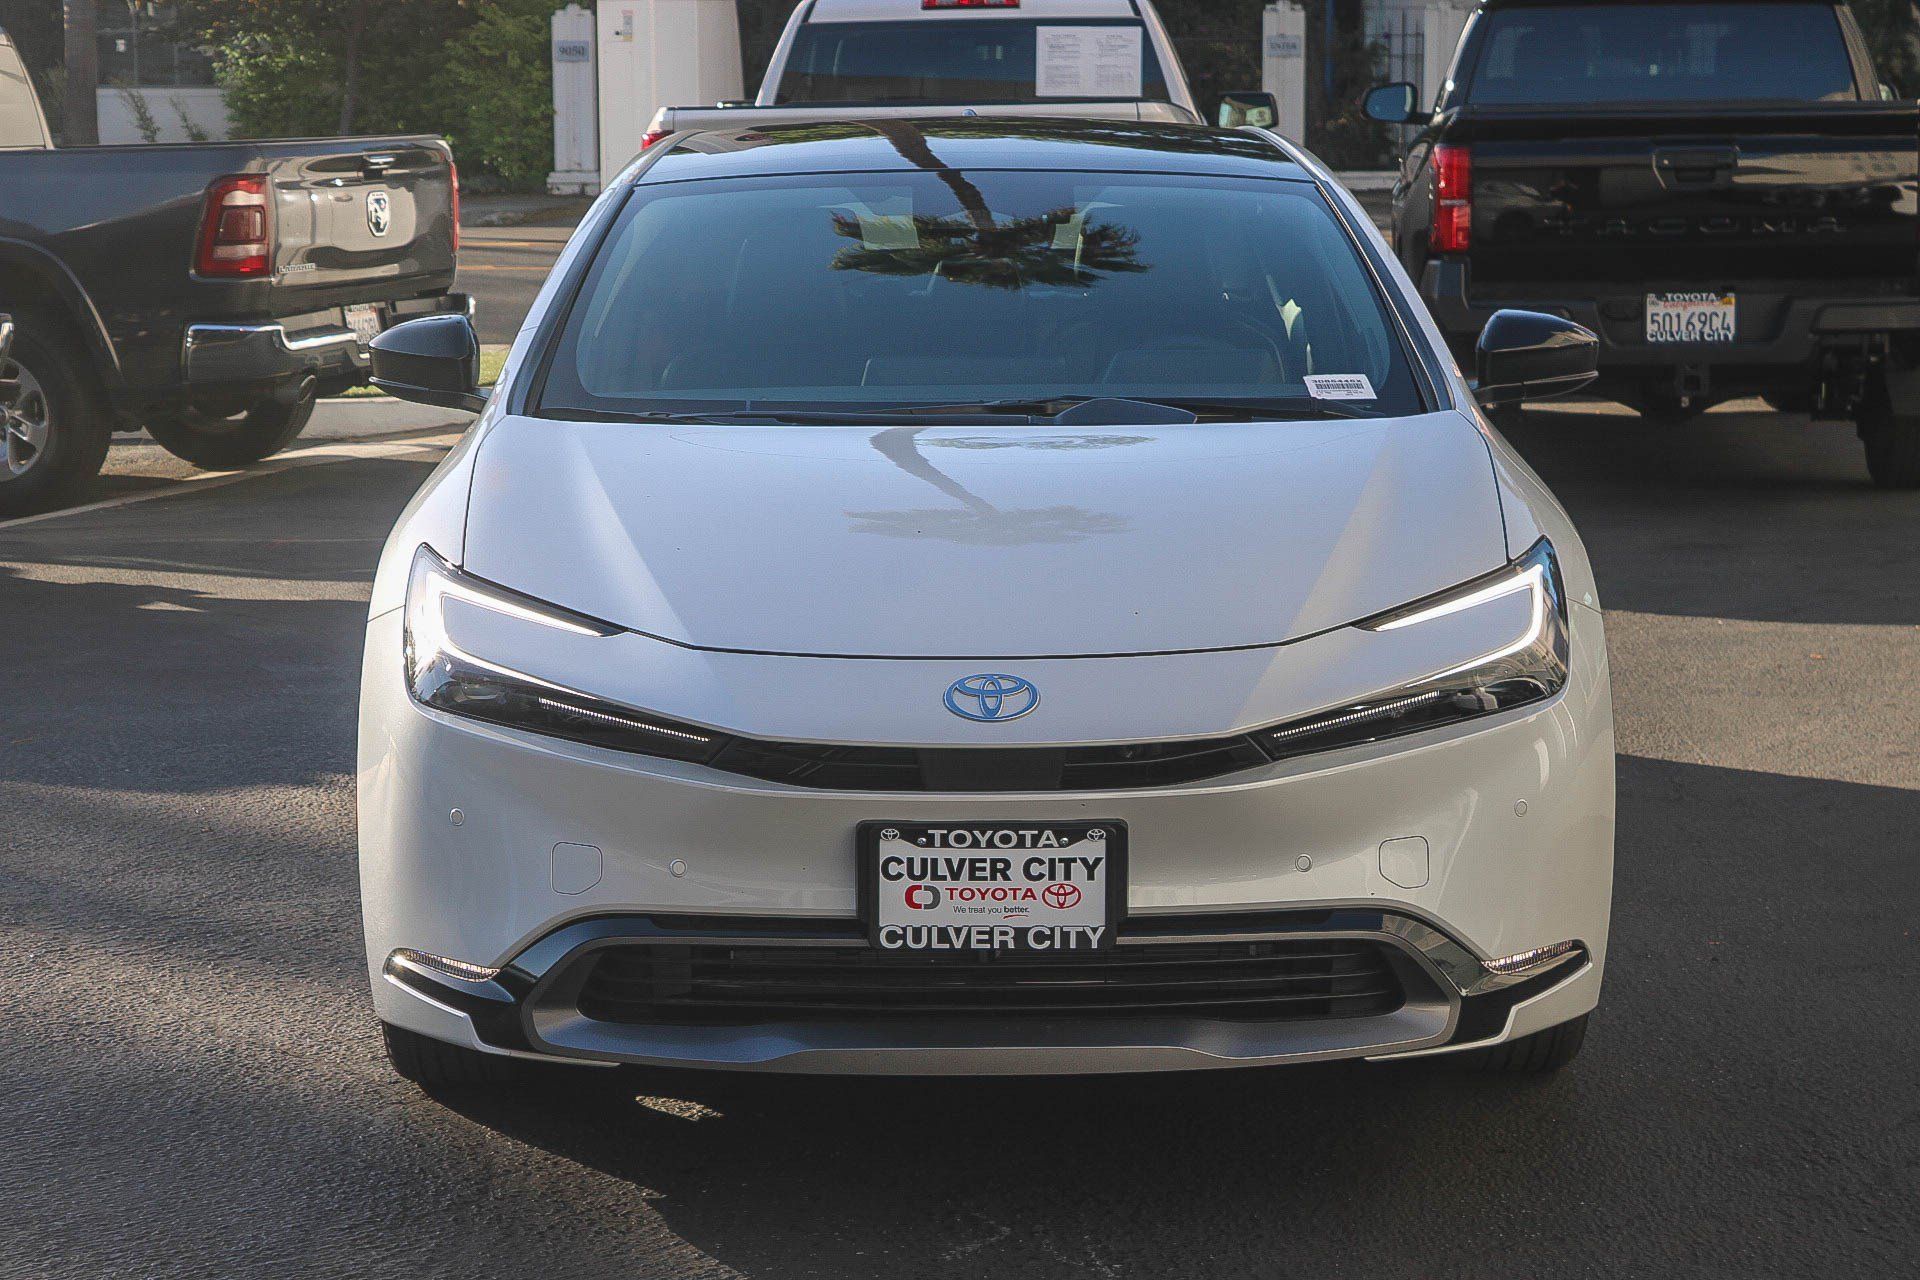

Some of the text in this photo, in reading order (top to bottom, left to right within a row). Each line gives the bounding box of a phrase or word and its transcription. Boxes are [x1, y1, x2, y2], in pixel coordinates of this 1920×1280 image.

[558, 45, 585, 57] 9050
[1665, 292, 1717, 302] TOYOTA
[1650, 311, 1732, 333] 50169C4
[1646, 331, 1734, 342] CULVER CITY
[928, 829, 1059, 848] TOYOTA
[880, 856, 1104, 882] CULVER CITY
[945, 887, 1037, 902] TOYOTA
[953, 906, 1030, 916] We treat you better.
[879, 926, 1106, 949] CULVER CITY
